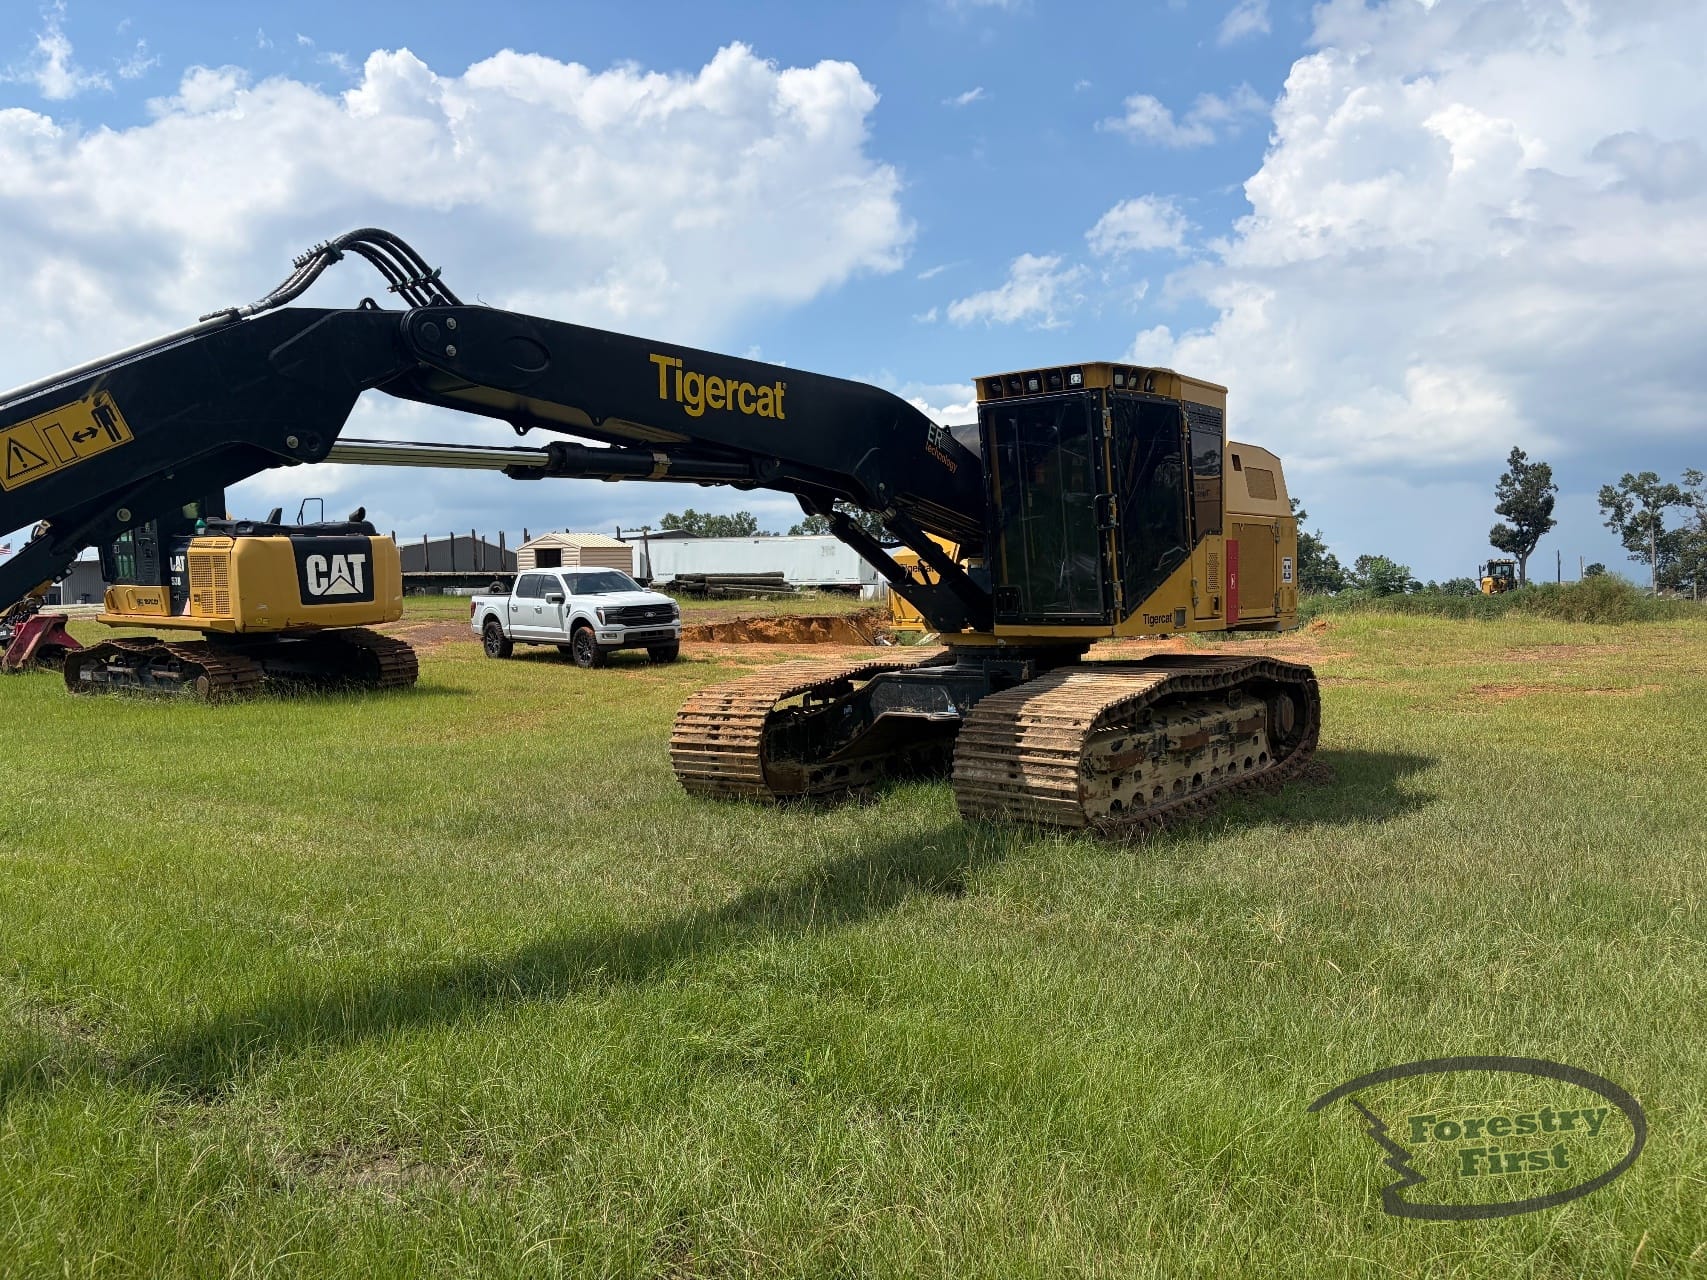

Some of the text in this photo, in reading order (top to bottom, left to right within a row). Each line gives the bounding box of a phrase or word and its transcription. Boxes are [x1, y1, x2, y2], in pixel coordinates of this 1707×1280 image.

[649, 353, 786, 420] Tigercat
[306, 553, 366, 596] CAT
[1143, 612, 1173, 628] Tigercat
